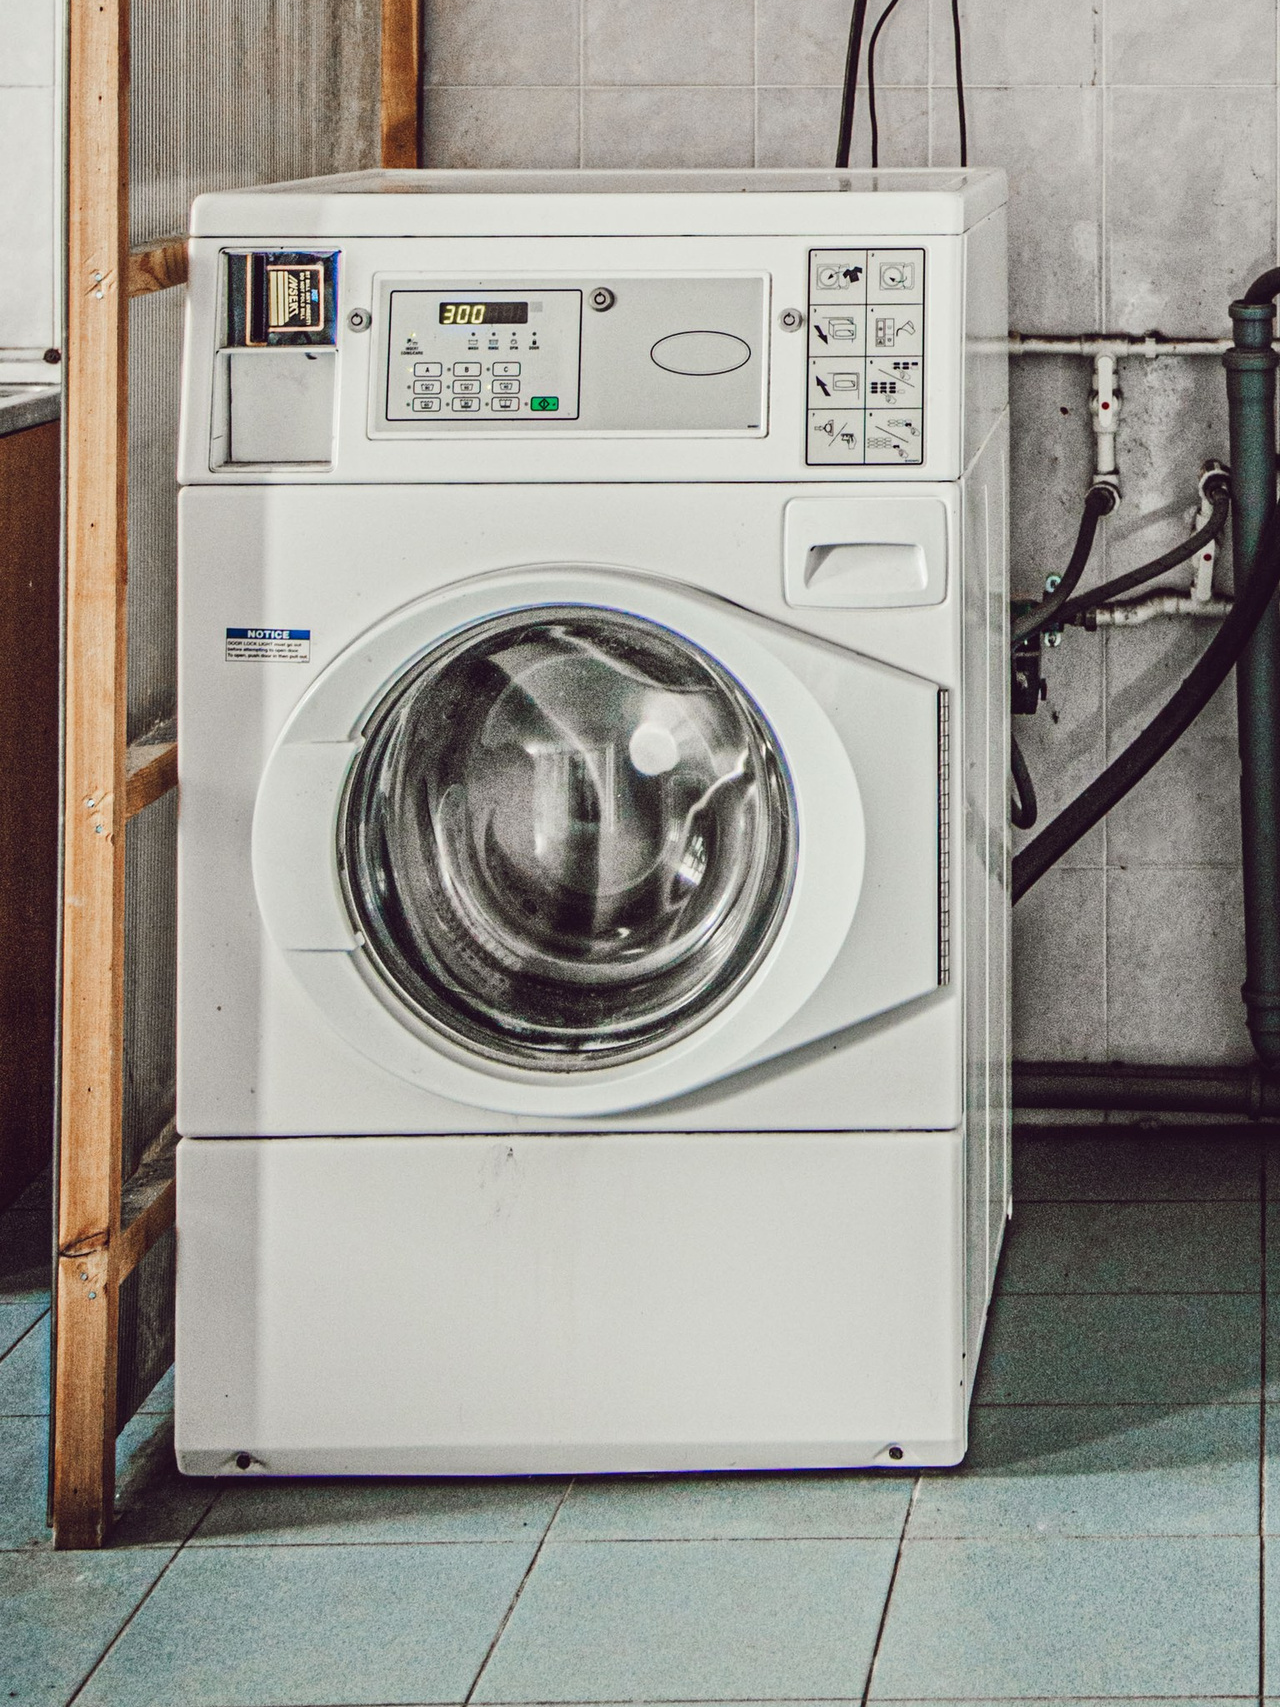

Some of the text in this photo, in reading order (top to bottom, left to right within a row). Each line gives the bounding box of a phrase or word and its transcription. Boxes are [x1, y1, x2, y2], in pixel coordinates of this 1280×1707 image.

[289, 274, 298, 318] INSERT
[443, 305, 486, 324] 300
[248, 630, 290, 639] NOTICE
